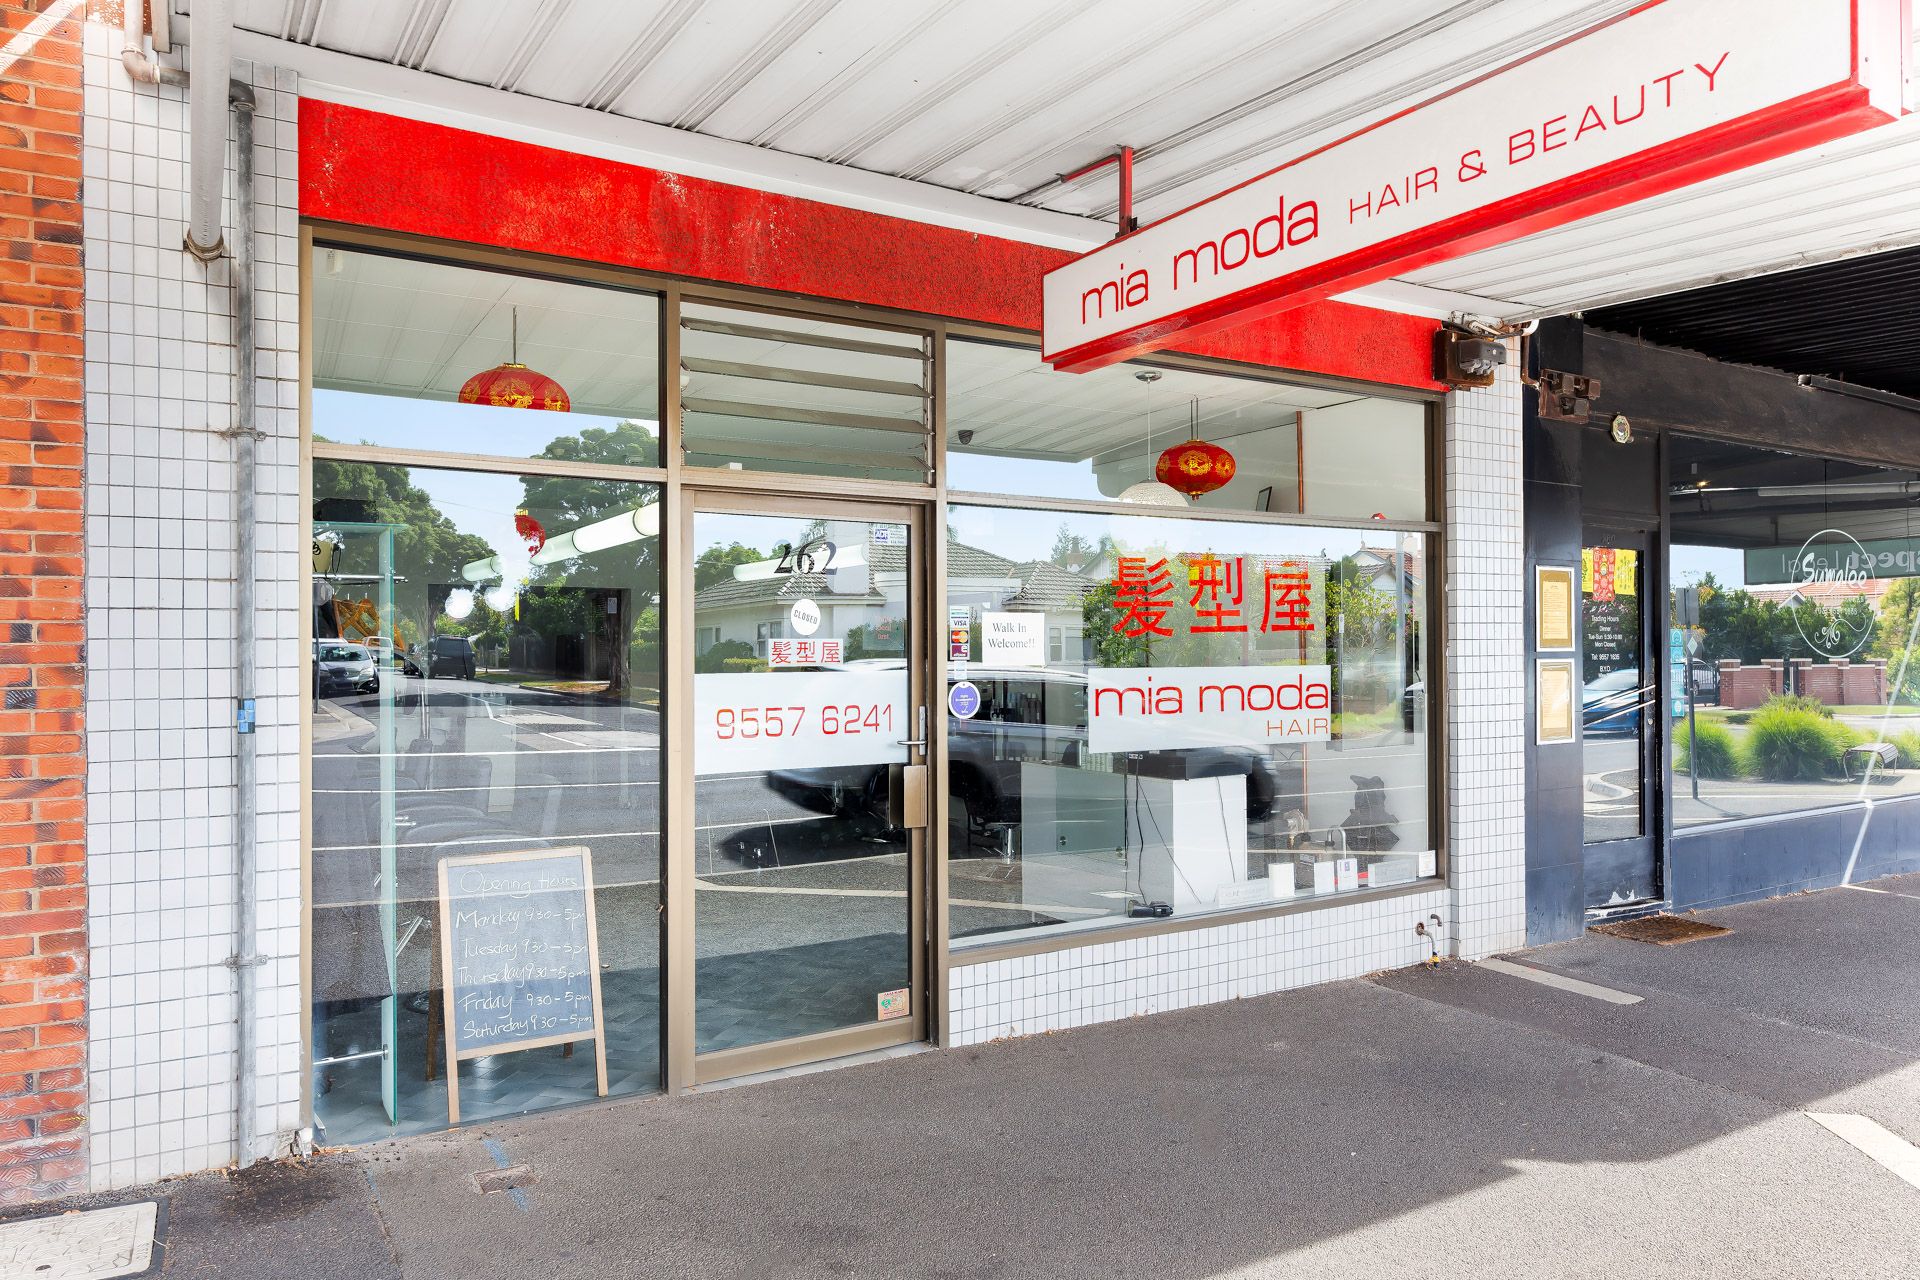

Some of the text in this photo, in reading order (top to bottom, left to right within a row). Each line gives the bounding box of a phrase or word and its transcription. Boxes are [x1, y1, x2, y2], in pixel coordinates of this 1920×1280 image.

[1082, 51, 1731, 325] mia moda HAIR & BEAUTY
[774, 540, 838, 575] 262
[1111, 557, 1315, 638] 髮型屋
[793, 609, 819, 625] CLOSED
[993, 622, 1028, 633] Walk In
[1591, 615, 1606, 623] Trading
[771, 641, 841, 664] 髮型屋
[988, 638, 1035, 649] Welcome!!
[1095, 673, 1329, 717] mia moda
[716, 703, 893, 740] 9557 6241
[1267, 718, 1329, 737] HAIR
[460, 868, 579, 903] Opening Hours
[456, 905, 521, 935] Monday
[461, 937, 518, 961] Tuesday
[458, 962, 526, 988] Thursday
[458, 990, 513, 1019] Friday
[463, 1017, 529, 1039] Saturday
